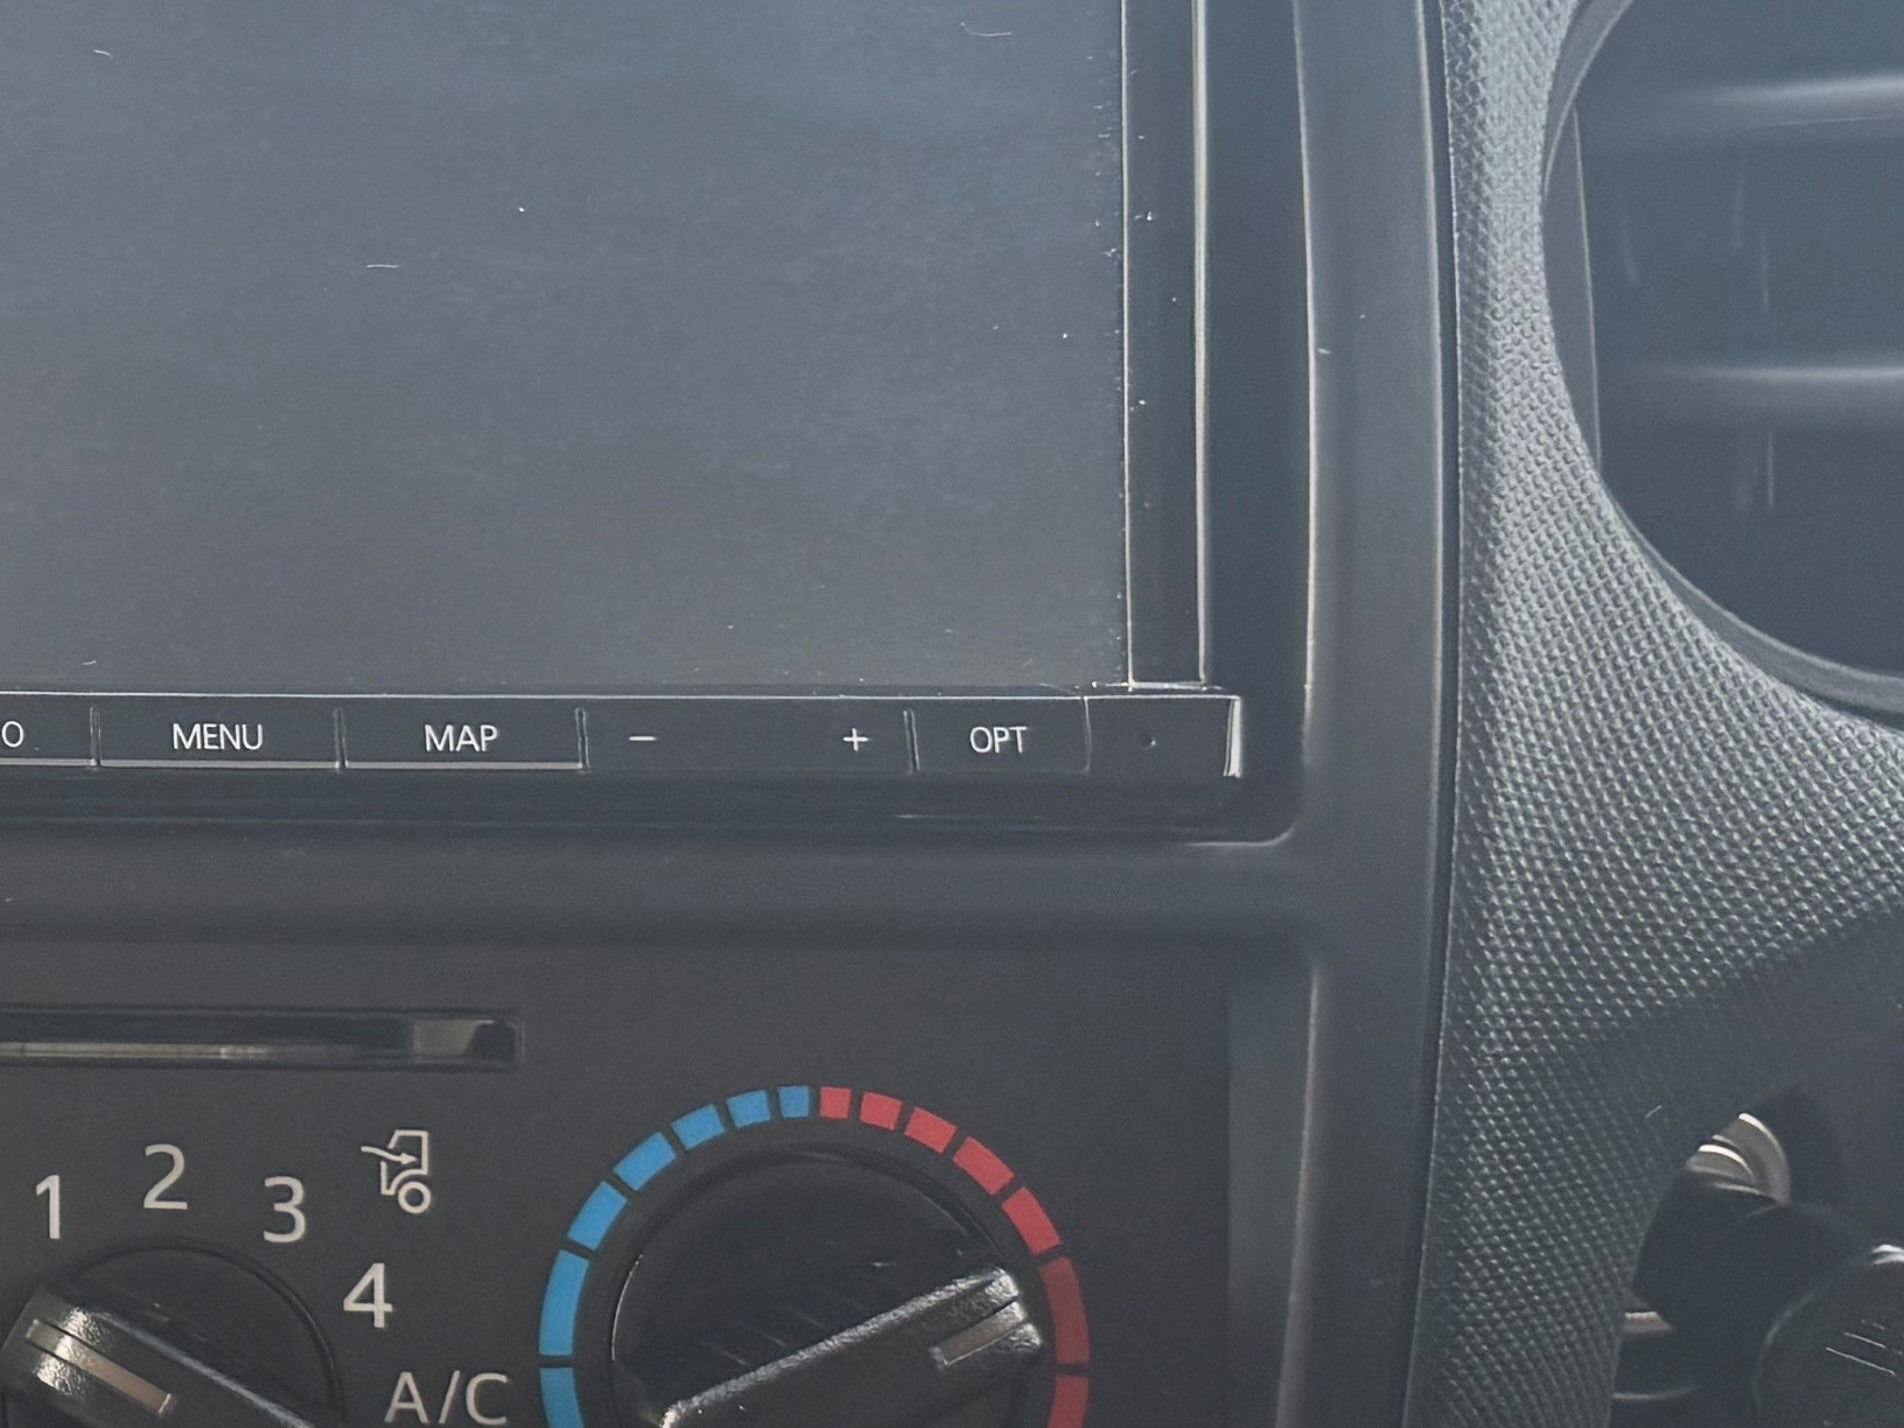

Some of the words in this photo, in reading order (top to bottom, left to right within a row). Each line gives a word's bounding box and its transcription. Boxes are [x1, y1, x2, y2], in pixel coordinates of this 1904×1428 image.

[174, 723, 262, 750] MENU
[425, 725, 497, 751] MAP
[971, 727, 1027, 753] OPT
[144, 1144, 187, 1209] 2
[36, 1175, 60, 1239] 1
[264, 1177, 305, 1242] 3
[344, 1263, 392, 1328] 4
[385, 1370, 507, 1425] A/C
